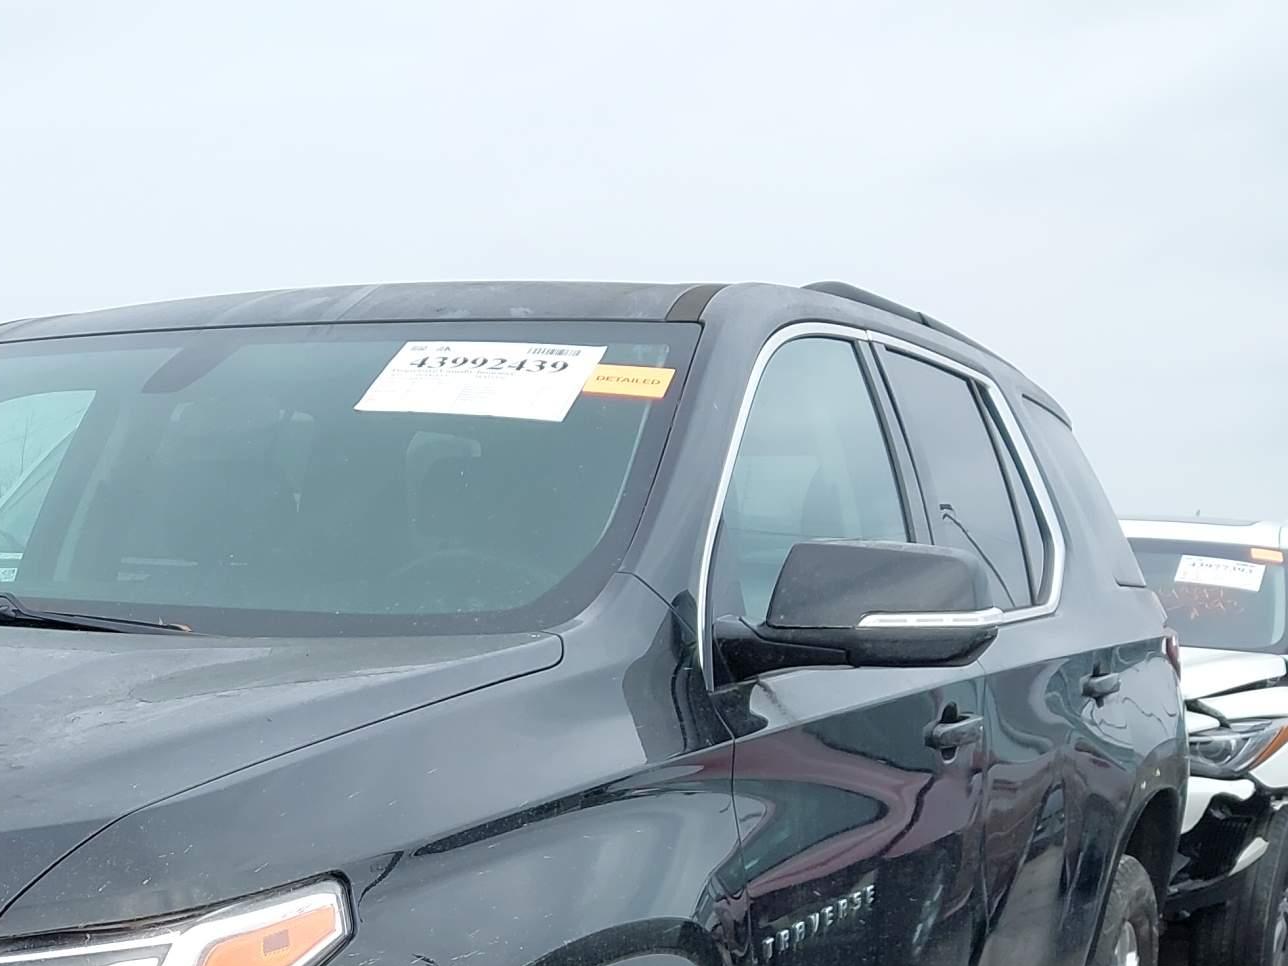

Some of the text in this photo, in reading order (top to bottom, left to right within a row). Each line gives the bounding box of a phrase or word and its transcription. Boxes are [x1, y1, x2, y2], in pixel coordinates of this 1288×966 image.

[409, 356, 569, 374] 43992439
[596, 375, 661, 385] DETAILED
[763, 884, 876, 961] TRAVERSE
